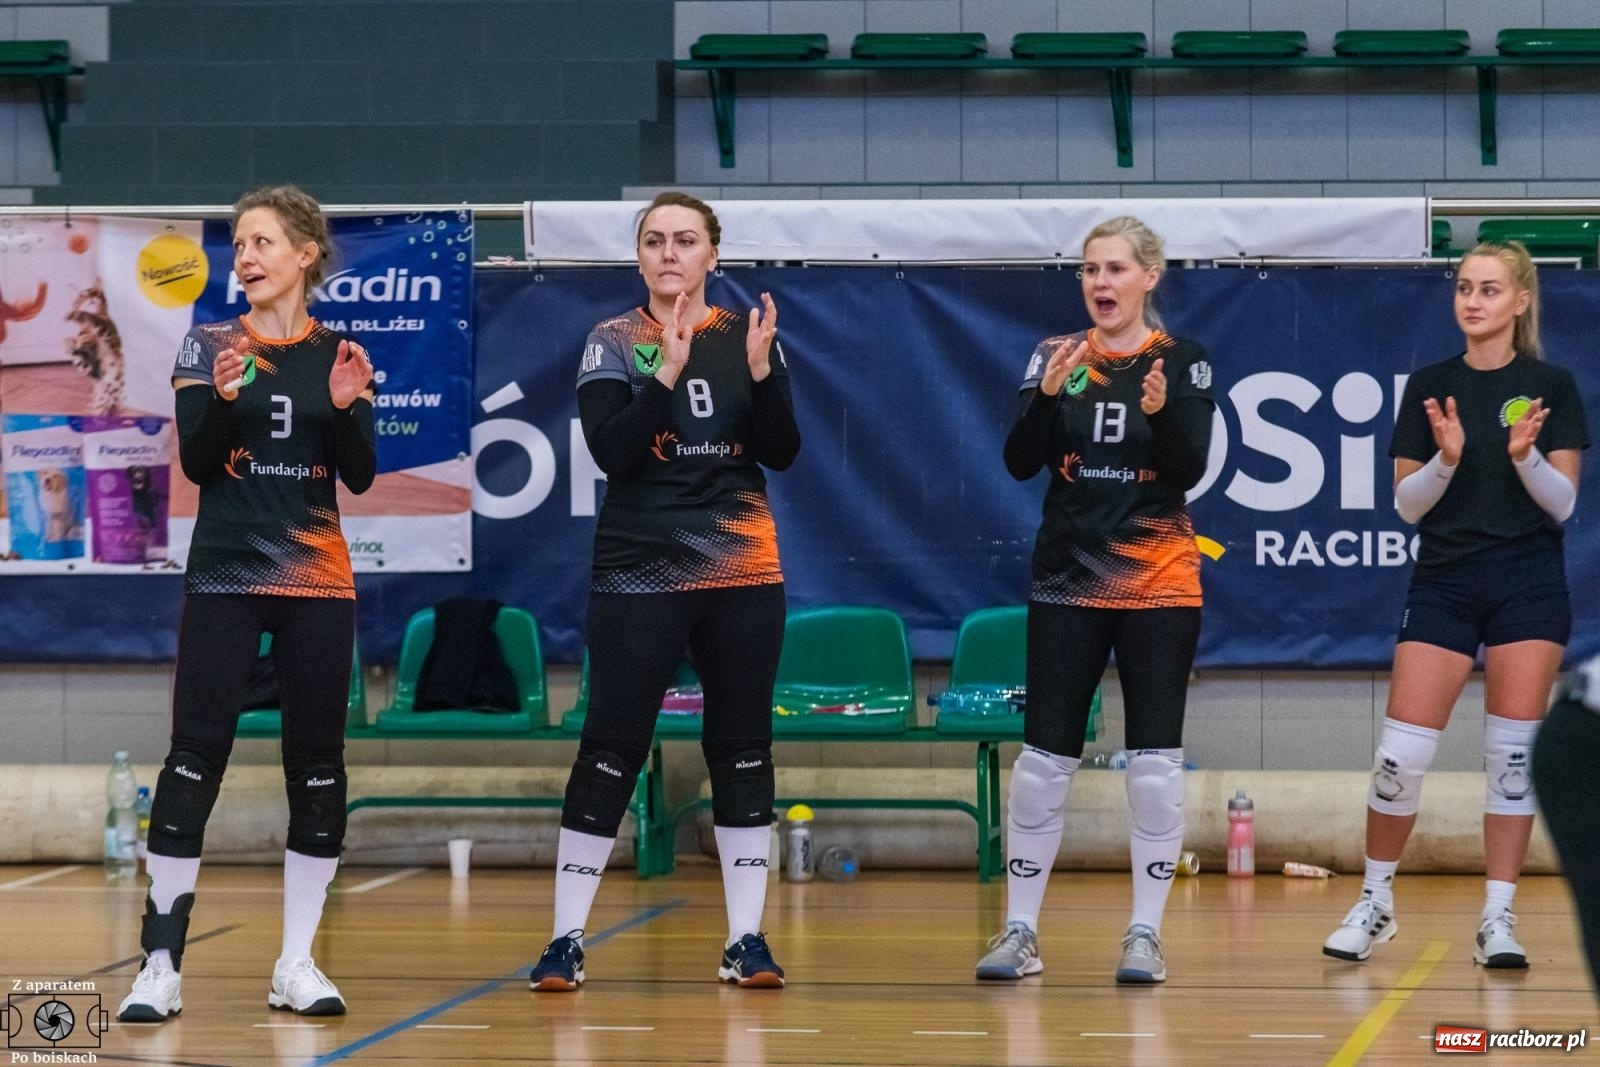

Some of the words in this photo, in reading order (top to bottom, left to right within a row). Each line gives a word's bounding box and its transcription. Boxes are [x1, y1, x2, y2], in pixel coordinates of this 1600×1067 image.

[270, 394, 293, 439] 3
[686, 378, 715, 418] 8
[1092, 401, 1127, 443] 13
[675, 441, 731, 458] Fundacja
[250, 462, 311, 480] Fundacja
